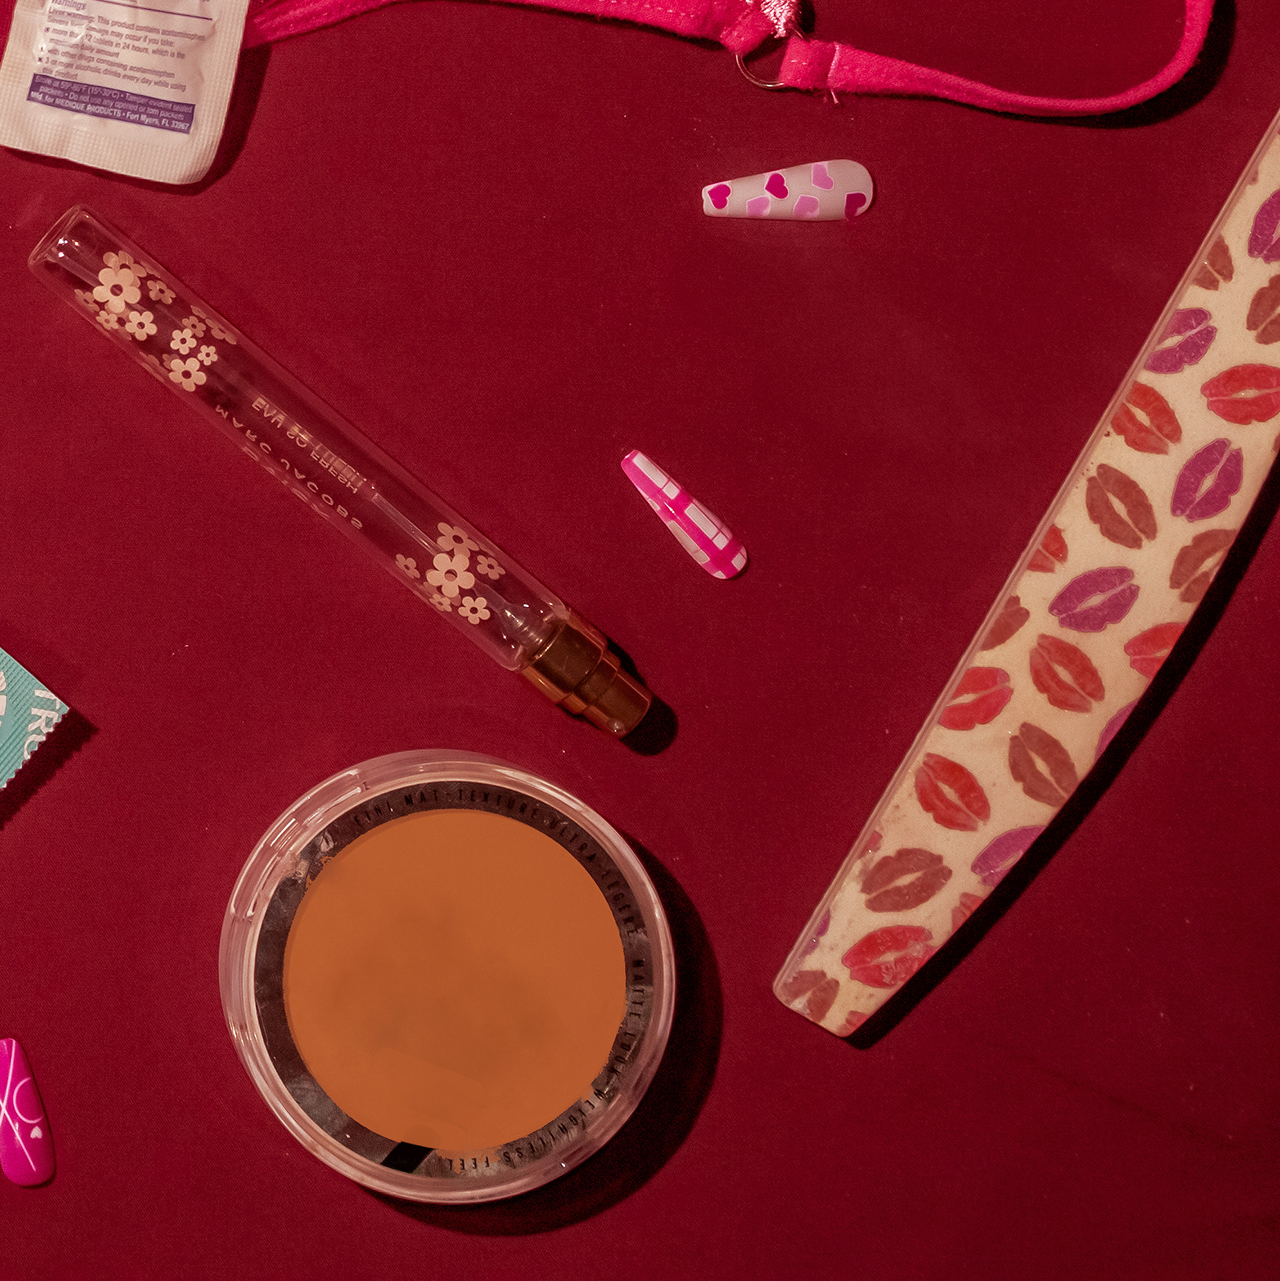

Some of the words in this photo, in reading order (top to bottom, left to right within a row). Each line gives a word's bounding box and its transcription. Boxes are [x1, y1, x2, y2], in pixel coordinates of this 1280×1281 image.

[97, 16, 109, 24] This
[110, 19, 135, 30] product
[135, 24, 160, 34] contains
[109, 29, 124, 39] may
[125, 32, 142, 42] occur
[147, 36, 159, 45] you
[47, 47, 60, 56] with
[60, 50, 77, 59] other
[77, 53, 95, 64] drugs
[95, 57, 128, 71] containing
[95, 47, 119, 58] amount
[122, 42, 130, 50] 24
[151, 47, 169, 57] which
[176, 51, 185, 59] the
[54, 69, 78, 80] product
[74, 63, 101, 74] alcoholic
[102, 68, 121, 78] drinks
[121, 73, 140, 83] every
[139, 76, 152, 86] day
[152, 78, 169, 88] while
[169, 82, 186, 93] using
[39, 86, 64, 97] packets
[68, 91, 78, 99] Do
[78, 93, 89, 102] not
[101, 99, 113, 108] any
[114, 100, 138, 112] opened
[159, 109, 184, 121] packets
[44, 95, 54, 103] for
[54, 97, 85, 110] MEDIQUE
[86, 103, 121, 117] PRODUCTS
[125, 111, 139, 120] Fort
[139, 114, 160, 126] Myers,
[161, 118, 170, 126] FL
[147, 98, 172, 109] evident
[172, 103, 192, 113] sealed
